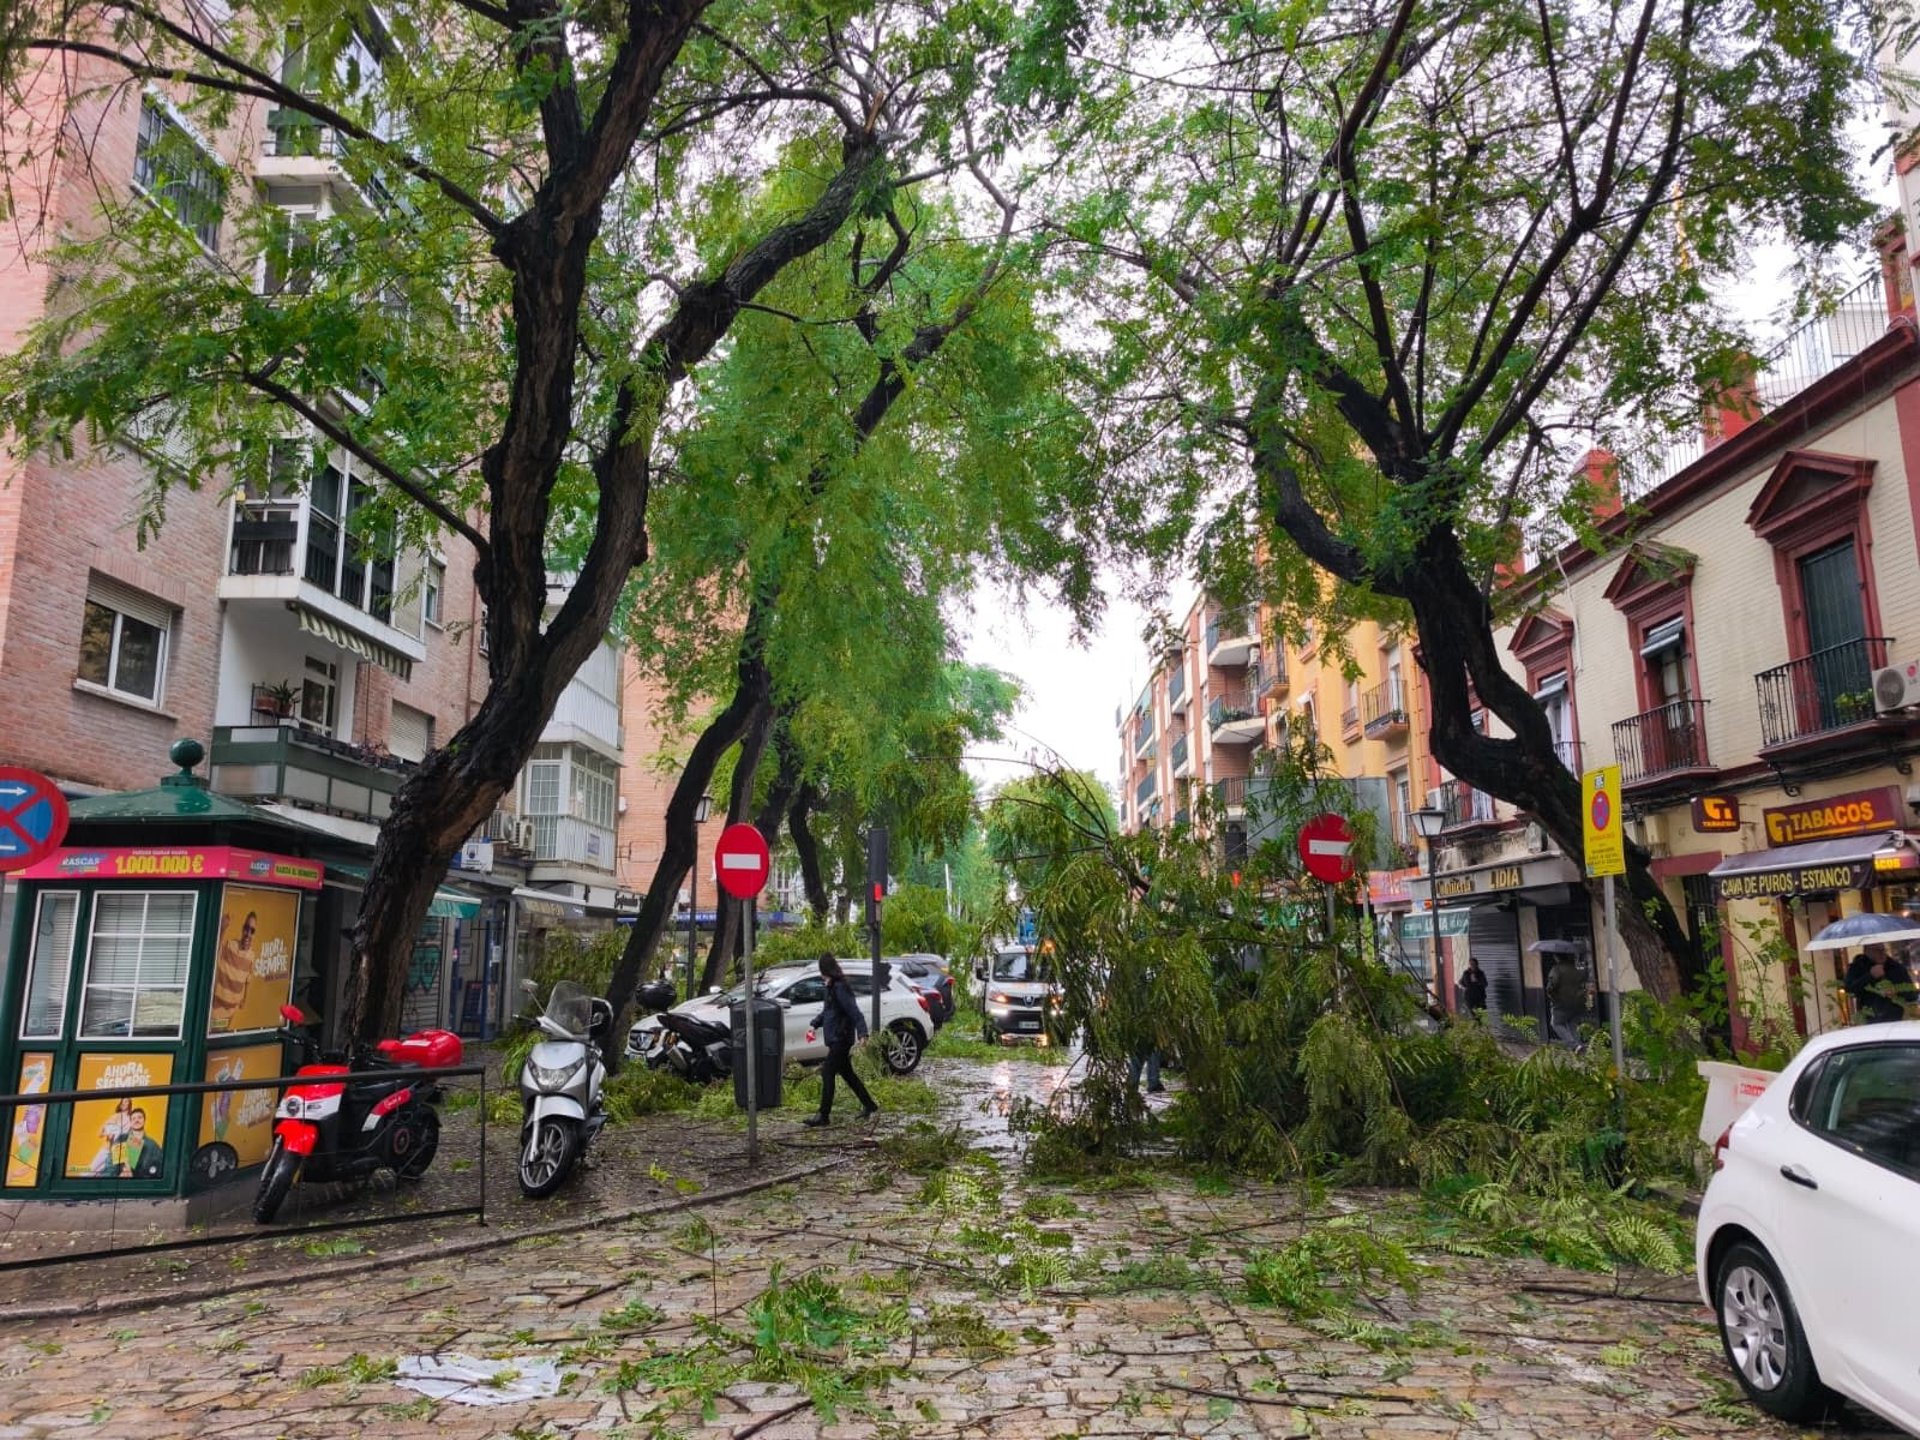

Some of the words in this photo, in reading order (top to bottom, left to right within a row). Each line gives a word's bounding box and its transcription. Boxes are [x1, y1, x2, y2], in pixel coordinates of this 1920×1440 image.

[1789, 801, 1874, 831] TABACOS
[1488, 866, 1522, 889] LIDIA
[1721, 878, 1742, 896] CAVA
[1744, 876, 1758, 894] DE
[1760, 873, 1793, 893] PUROS
[1801, 866, 1851, 890] ESTANCO
[104, 1062, 143, 1080] AHORA
